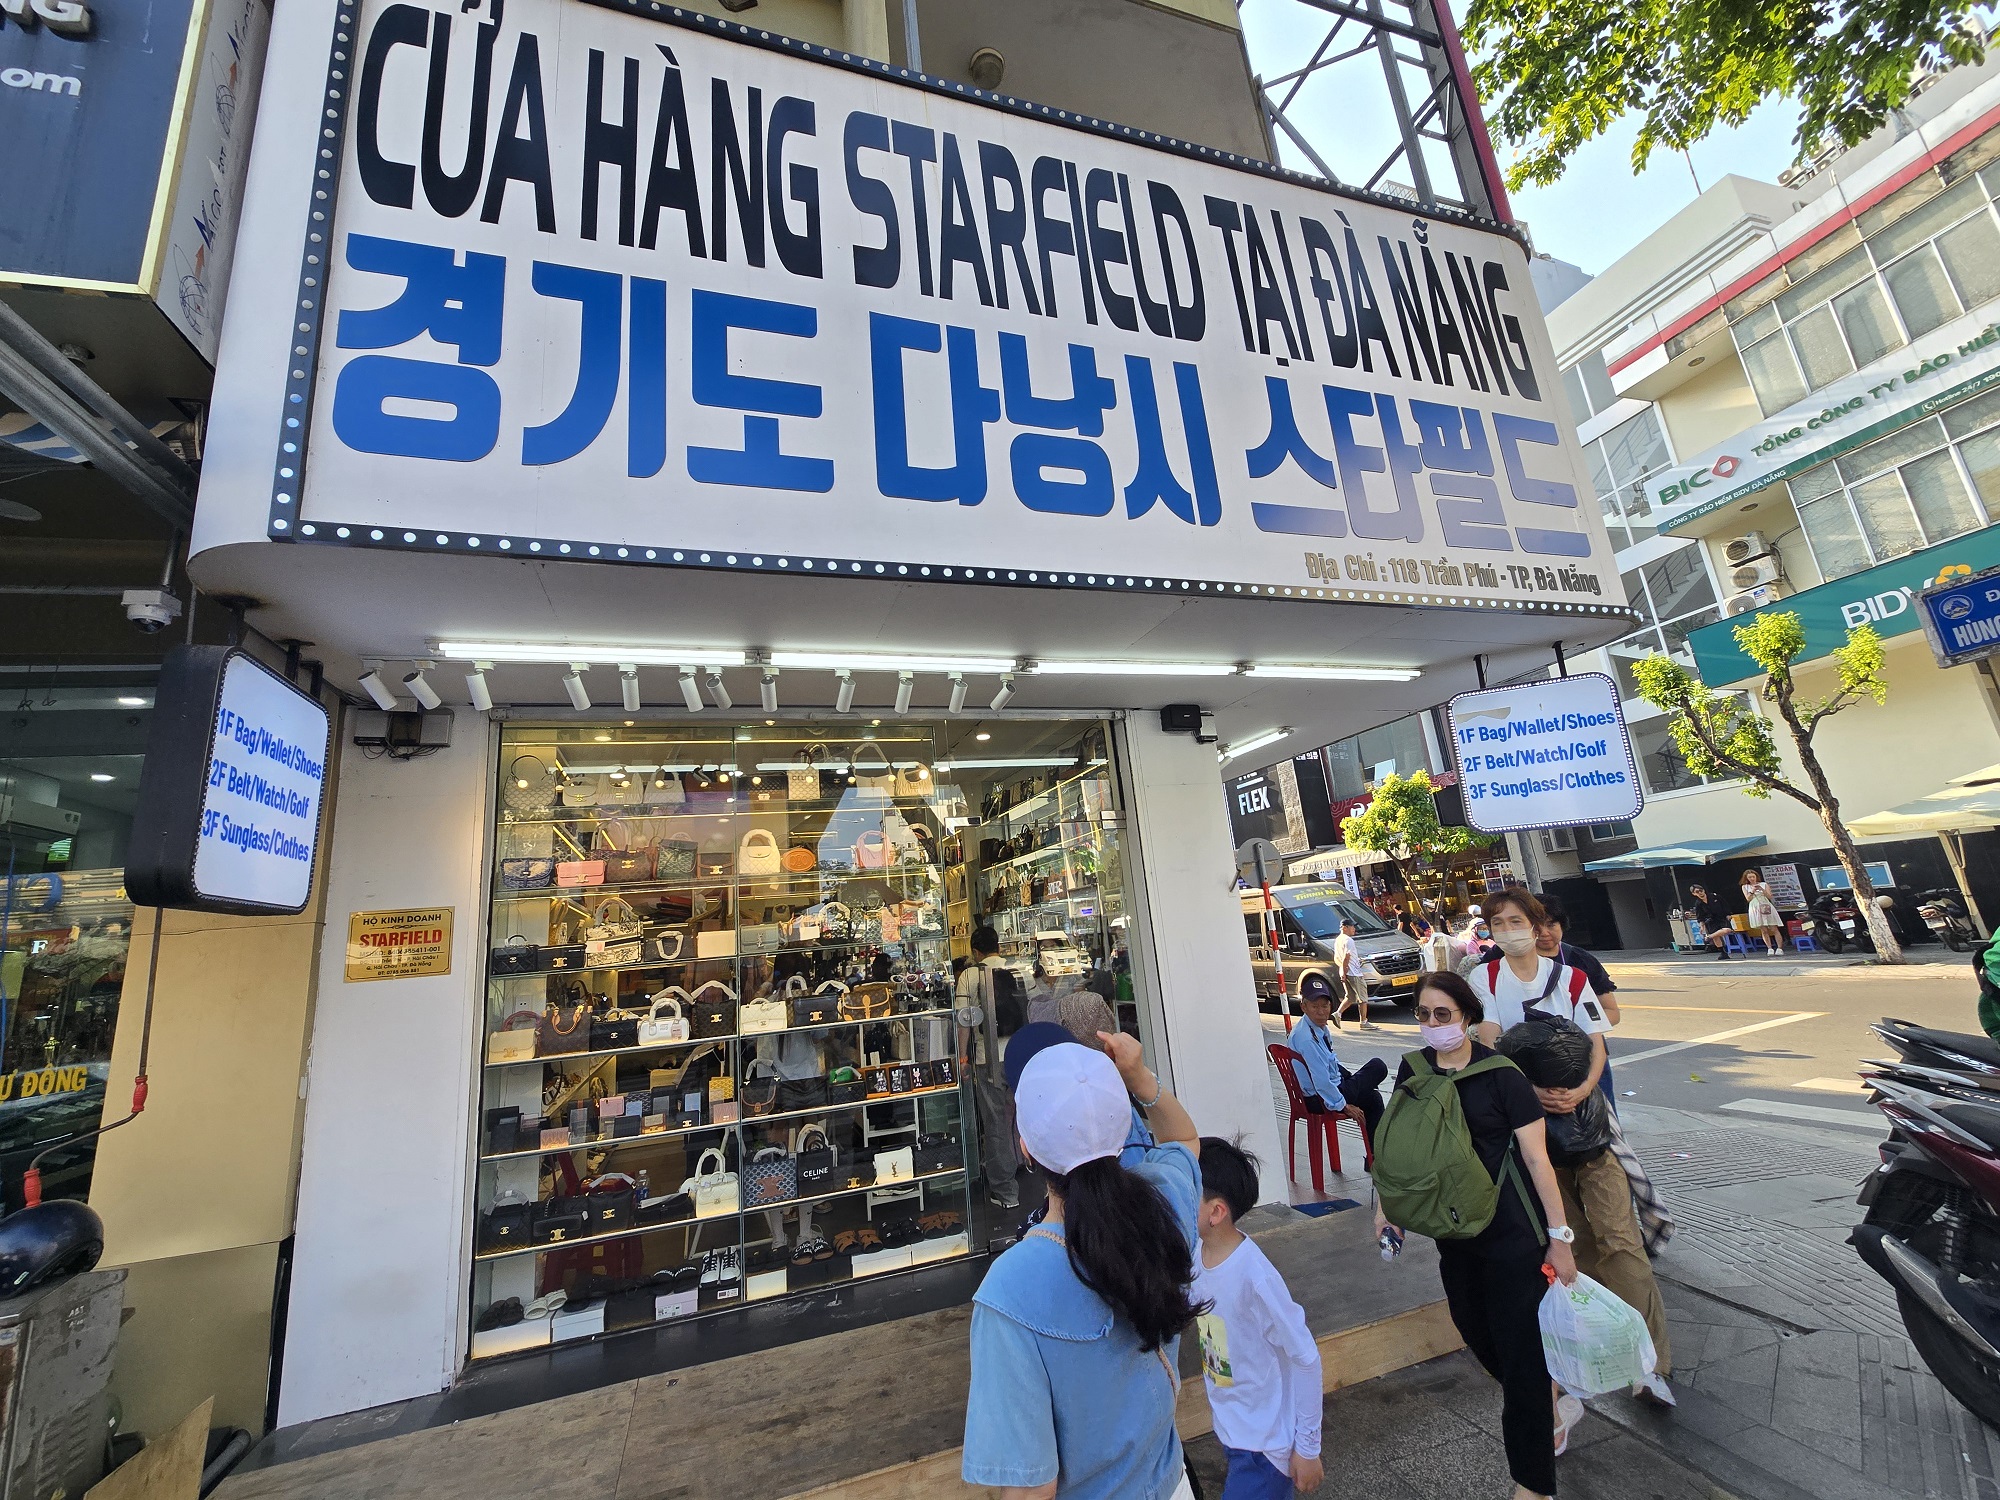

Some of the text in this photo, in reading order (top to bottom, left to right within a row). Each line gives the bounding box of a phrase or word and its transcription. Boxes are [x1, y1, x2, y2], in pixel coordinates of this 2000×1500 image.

[357, 0, 1541, 402] CỬA HÀNG STARFIELD TẠI ĐÀ NẴNG
[333, 232, 1592, 558] 경기도 다낭시 스타필드
[1807, 396, 1865, 430] CÔNG
[1867, 378, 1896, 399] TY
[1658, 468, 1711, 505] BIC
[1688, 510, 1699, 519] TY
[1305, 552, 1339, 584] Địa
[1344, 552, 1378, 582] Chỉ
[1388, 559, 1420, 584] 118
[1421, 557, 1463, 586] Trần
[1463, 563, 1499, 588] Phú
[1534, 567, 1559, 591] Đà
[1557, 564, 1602, 595] Nẵng
[219, 708, 322, 780] 1F Bag/Wallet/Shoes
[1458, 712, 1616, 744] 1F Bag/Wallet/Shoes
[1464, 740, 1607, 772] 2F Belt/Watch/Golf
[210, 758, 310, 819] 2F Belt/Watch/Golf
[1238, 786, 1271, 815] FLEX
[1469, 770, 1626, 799] 3F Sunglass/Clothes
[202, 809, 309, 862] 3F Sunglass/Clothes
[359, 929, 443, 948] STARFIELD
[363, 914, 441, 927] HỘ KINH DOANH
[21, 1062, 88, 1099] ĐỘNG
[803, 1166, 829, 1178] CELINE
